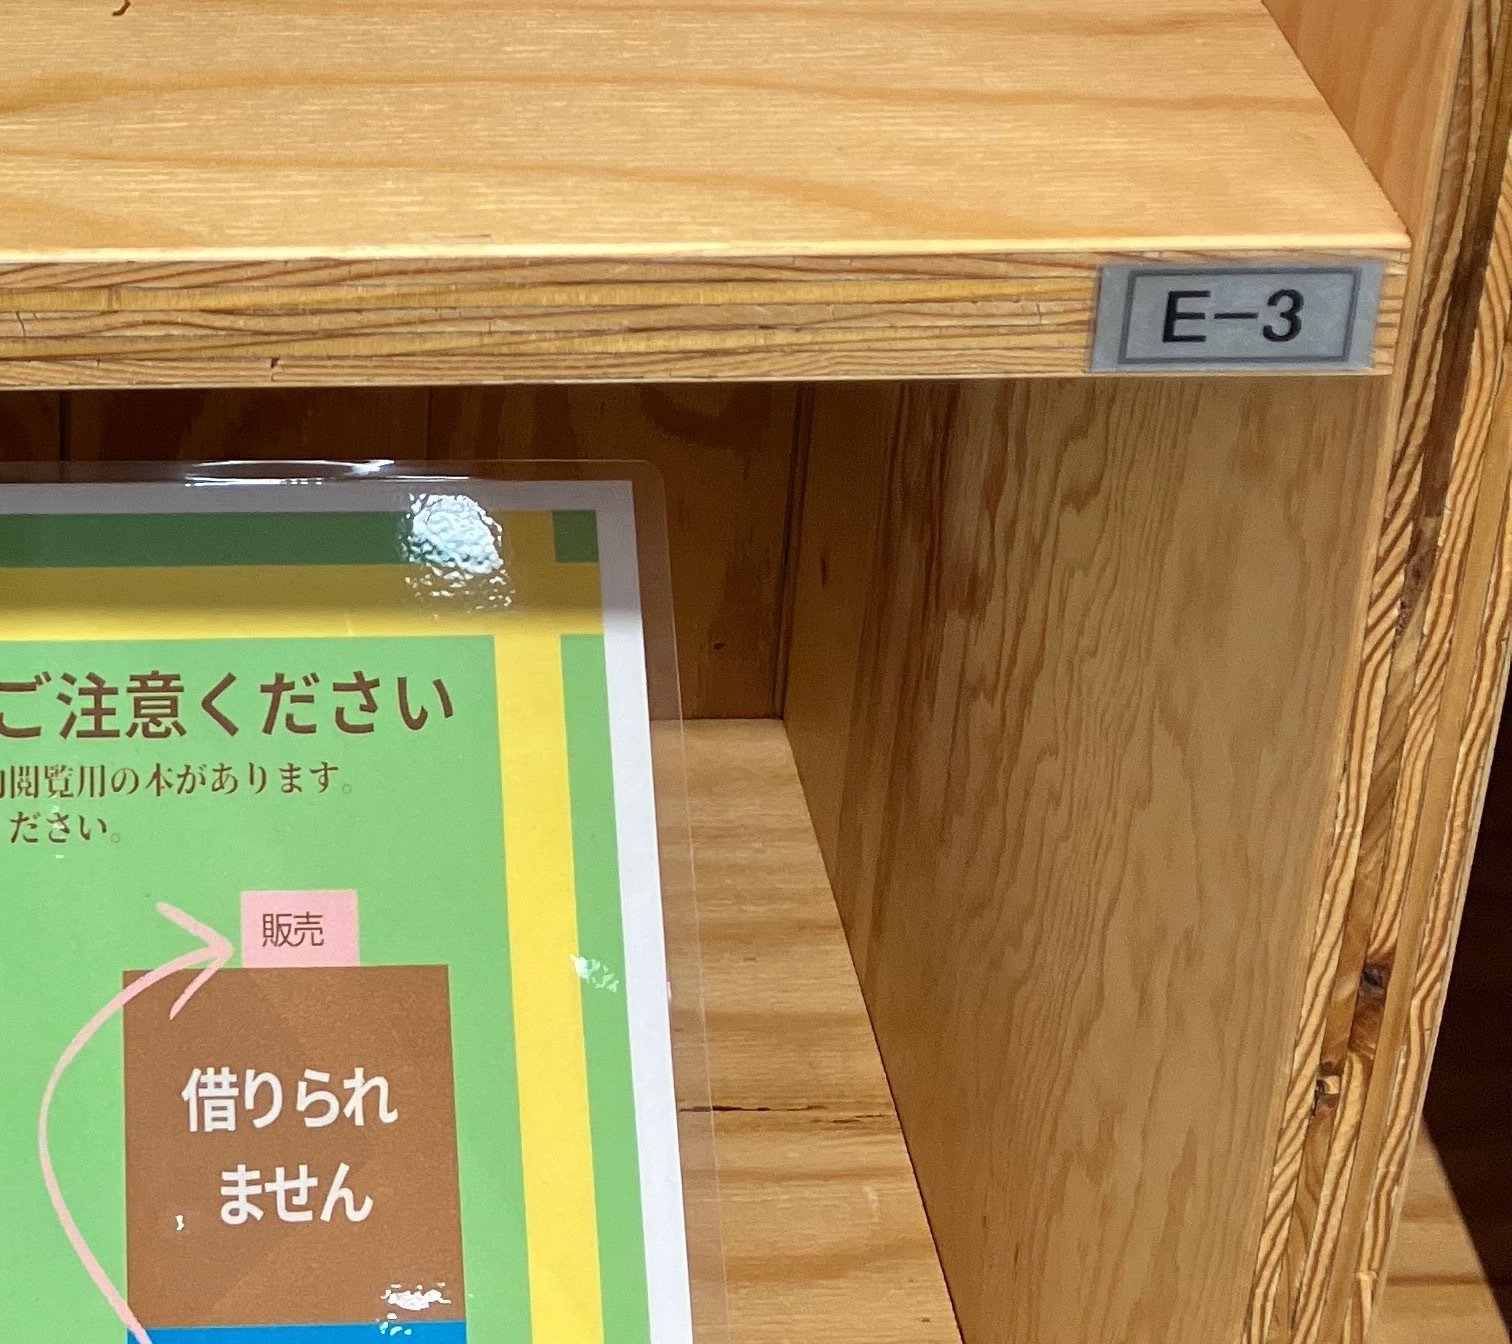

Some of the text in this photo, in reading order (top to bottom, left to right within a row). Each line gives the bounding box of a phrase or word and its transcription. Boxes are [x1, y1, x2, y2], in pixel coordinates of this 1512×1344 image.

[260, 912, 324, 948] 販売
[181, 1066, 398, 1133] 借りられ
[219, 1162, 374, 1226] ません
